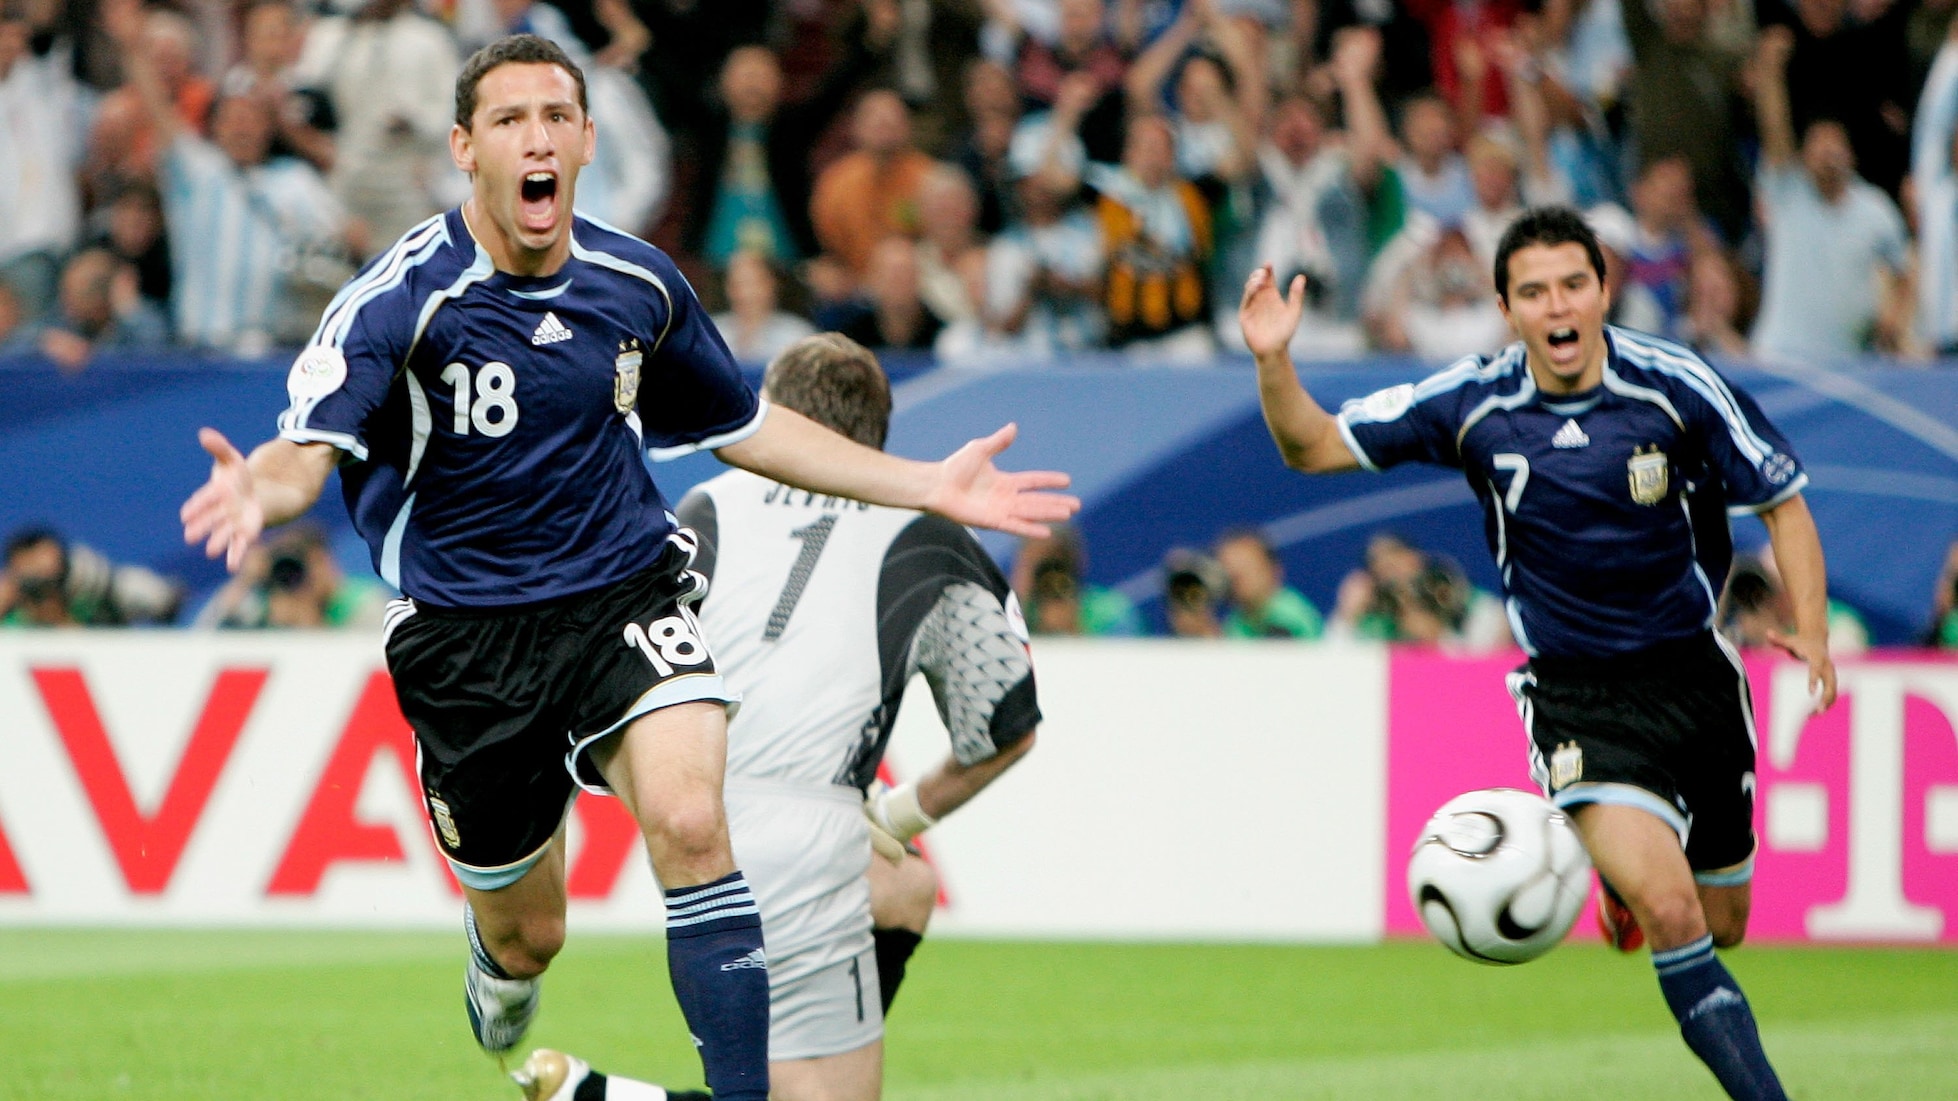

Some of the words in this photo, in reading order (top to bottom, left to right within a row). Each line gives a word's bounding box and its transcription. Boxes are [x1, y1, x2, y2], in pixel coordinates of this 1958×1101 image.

[532, 328, 574, 346] adidas
[440, 361, 519, 438] 18
[1493, 453, 1530, 515] 7
[761, 514, 839, 642] 1
[623, 616, 708, 677] 18
[1766, 662, 1958, 943] T
[848, 955, 864, 1022] 1
